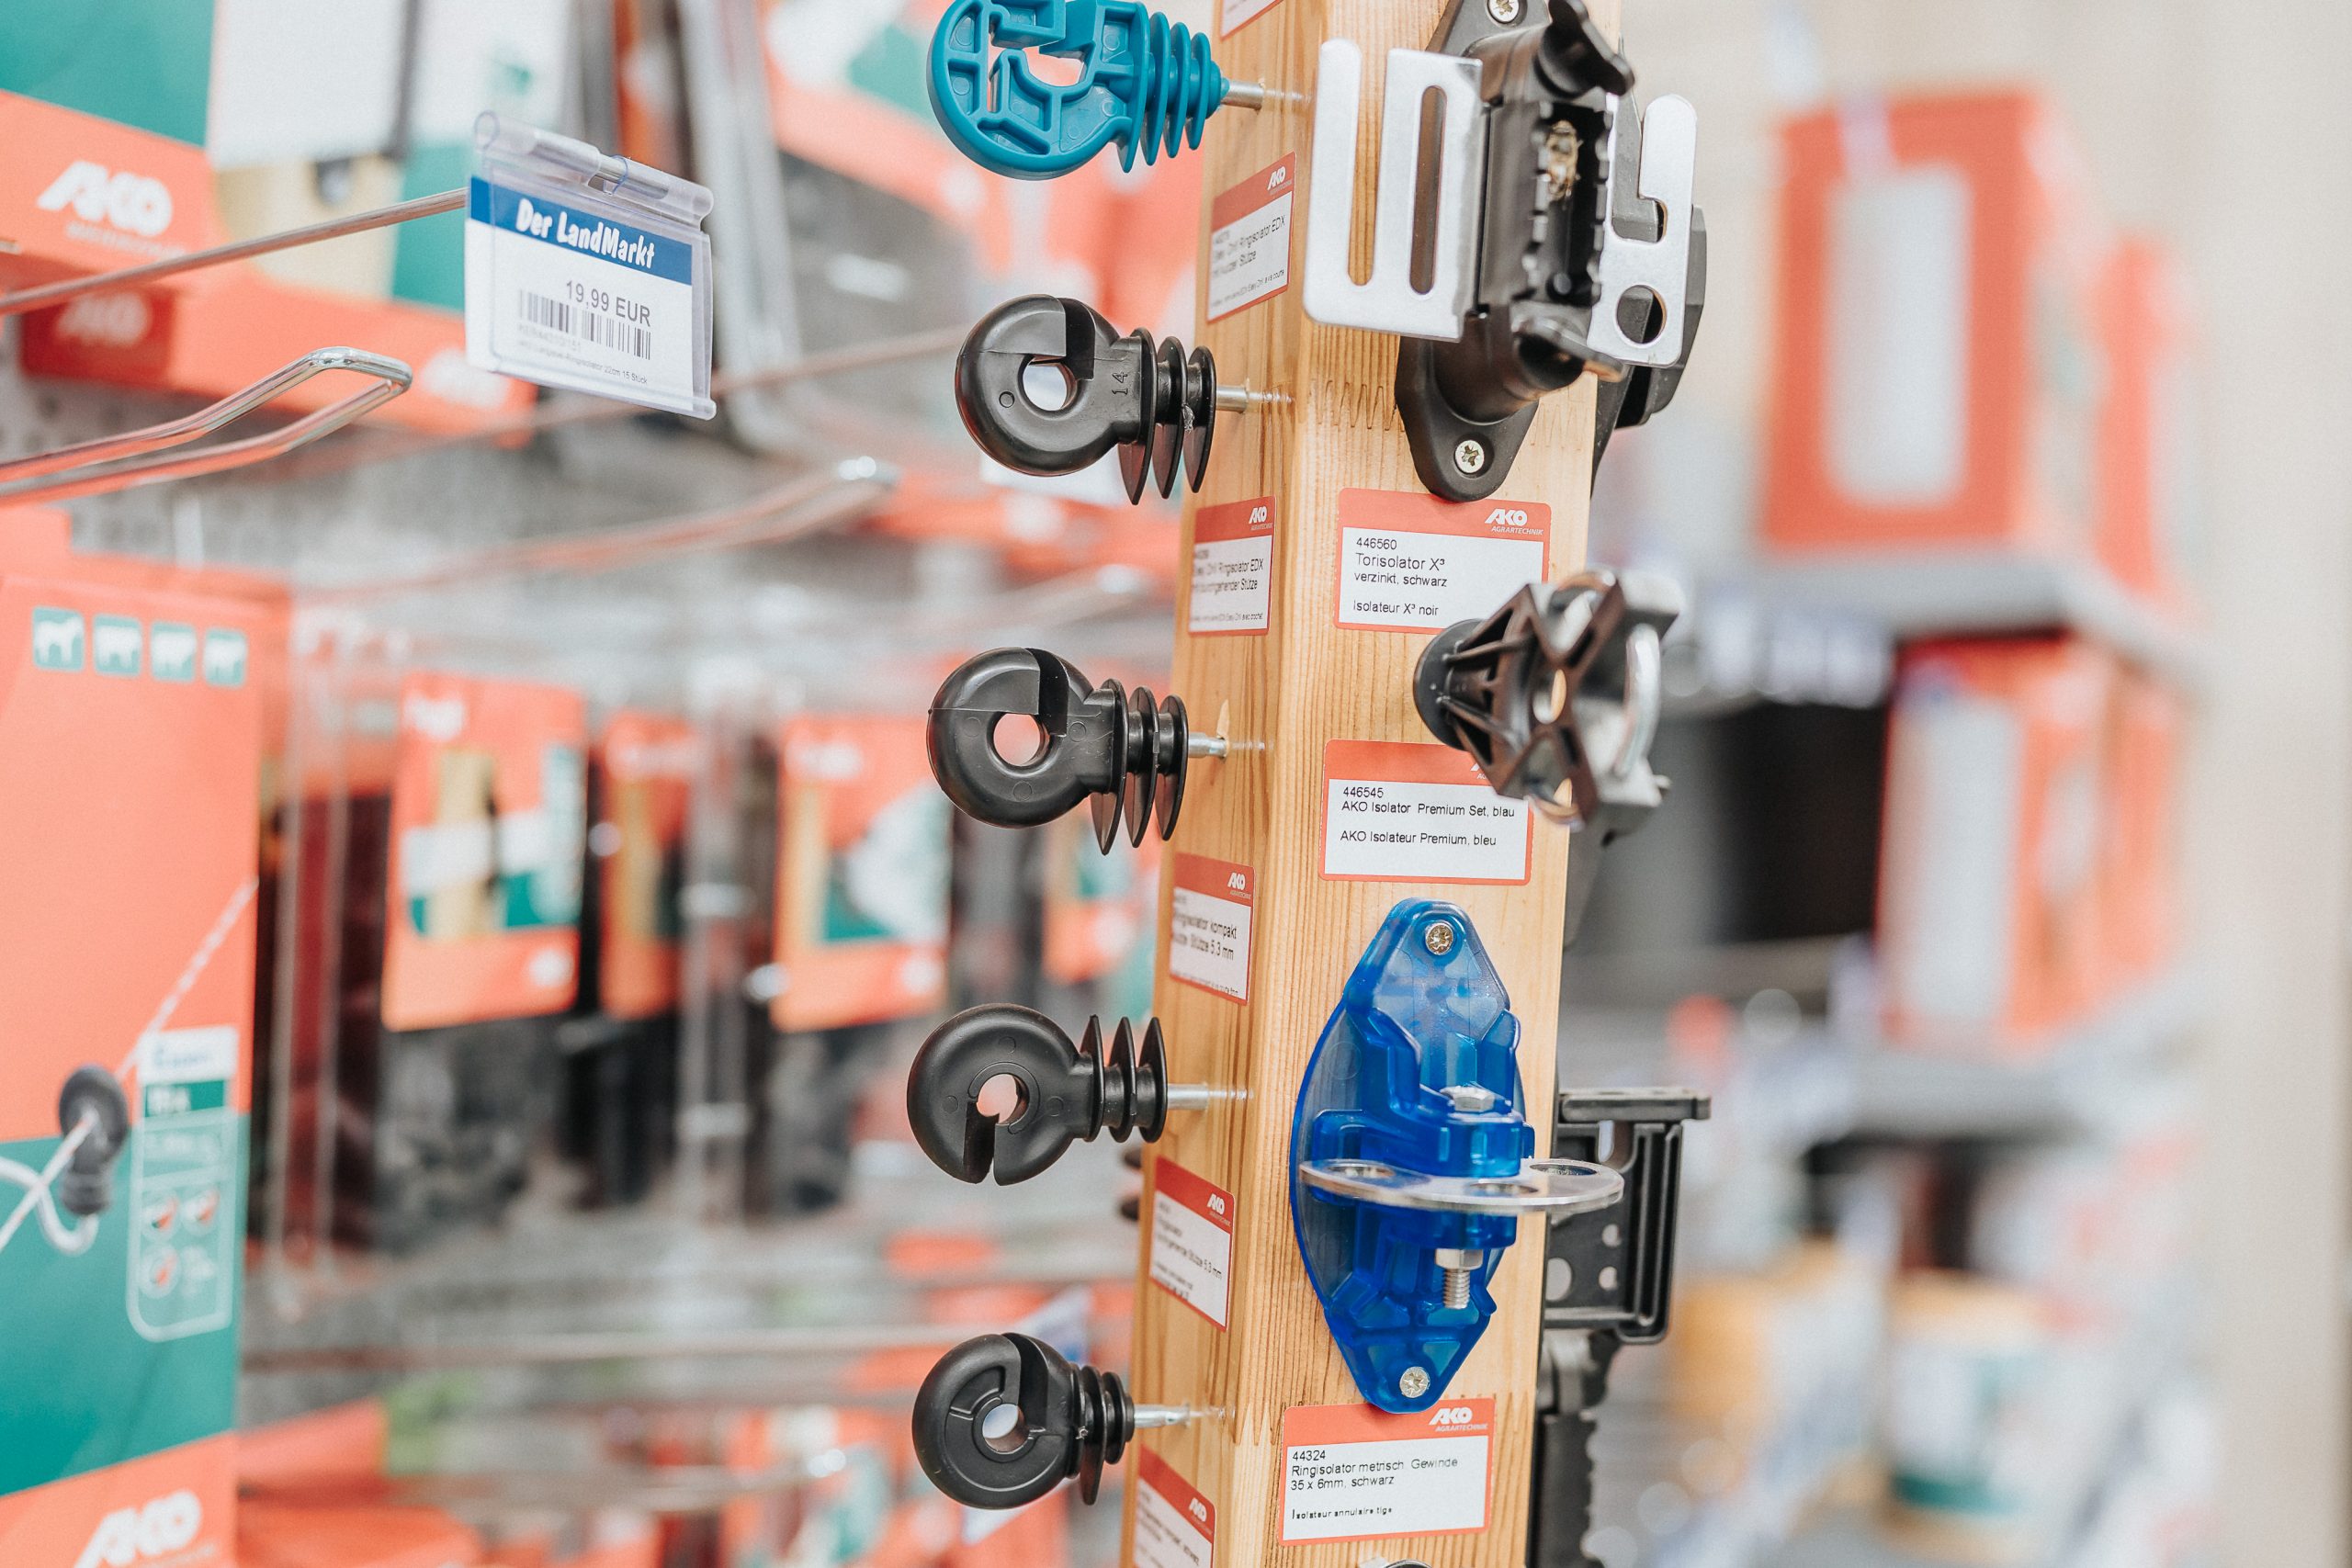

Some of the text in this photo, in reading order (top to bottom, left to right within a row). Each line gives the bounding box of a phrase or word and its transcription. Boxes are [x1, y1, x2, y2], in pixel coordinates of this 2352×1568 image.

[1267, 166, 1286, 190] AKO
[515, 197, 655, 269] Der LandMarkt
[566, 280, 651, 327] 19,99 EUR
[622, 370, 630, 379] 15
[1112, 371, 1129, 395] 14
[1249, 505, 1268, 525] AKO
[1485, 508, 1528, 526] AKO
[1490, 525, 1544, 536] AGRARTECHNIK
[1355, 536, 1397, 551] 446560
[1250, 558, 1264, 573] EDX
[1355, 553, 1445, 571] Torisolator X³
[1403, 573, 1447, 587] schwarz
[1352, 599, 1400, 614] Isolateur
[1419, 604, 1440, 616] noir
[1342, 786, 1384, 799] 446545
[1341, 800, 1515, 818] AKO Isolator Premium Set, blau
[1340, 830, 1497, 846] AKO Isolateur Premium, bleu
[1227, 872, 1246, 891] AKO
[1210, 919, 1237, 941] kompakt
[1222, 946, 1234, 961] mm
[1206, 1194, 1226, 1215] AKO
[1429, 1406, 1473, 1426] AKO
[1292, 1450, 1326, 1461] 44324
[1291, 1458, 1458, 1479] Ringisolator metrisch Gewinde
[1290, 1480, 1305, 1491] 35
[1306, 1481, 1314, 1490] x
[1351, 1475, 1395, 1487] schwarz
[1292, 1506, 1392, 1519] Isolateur annulaire tige
